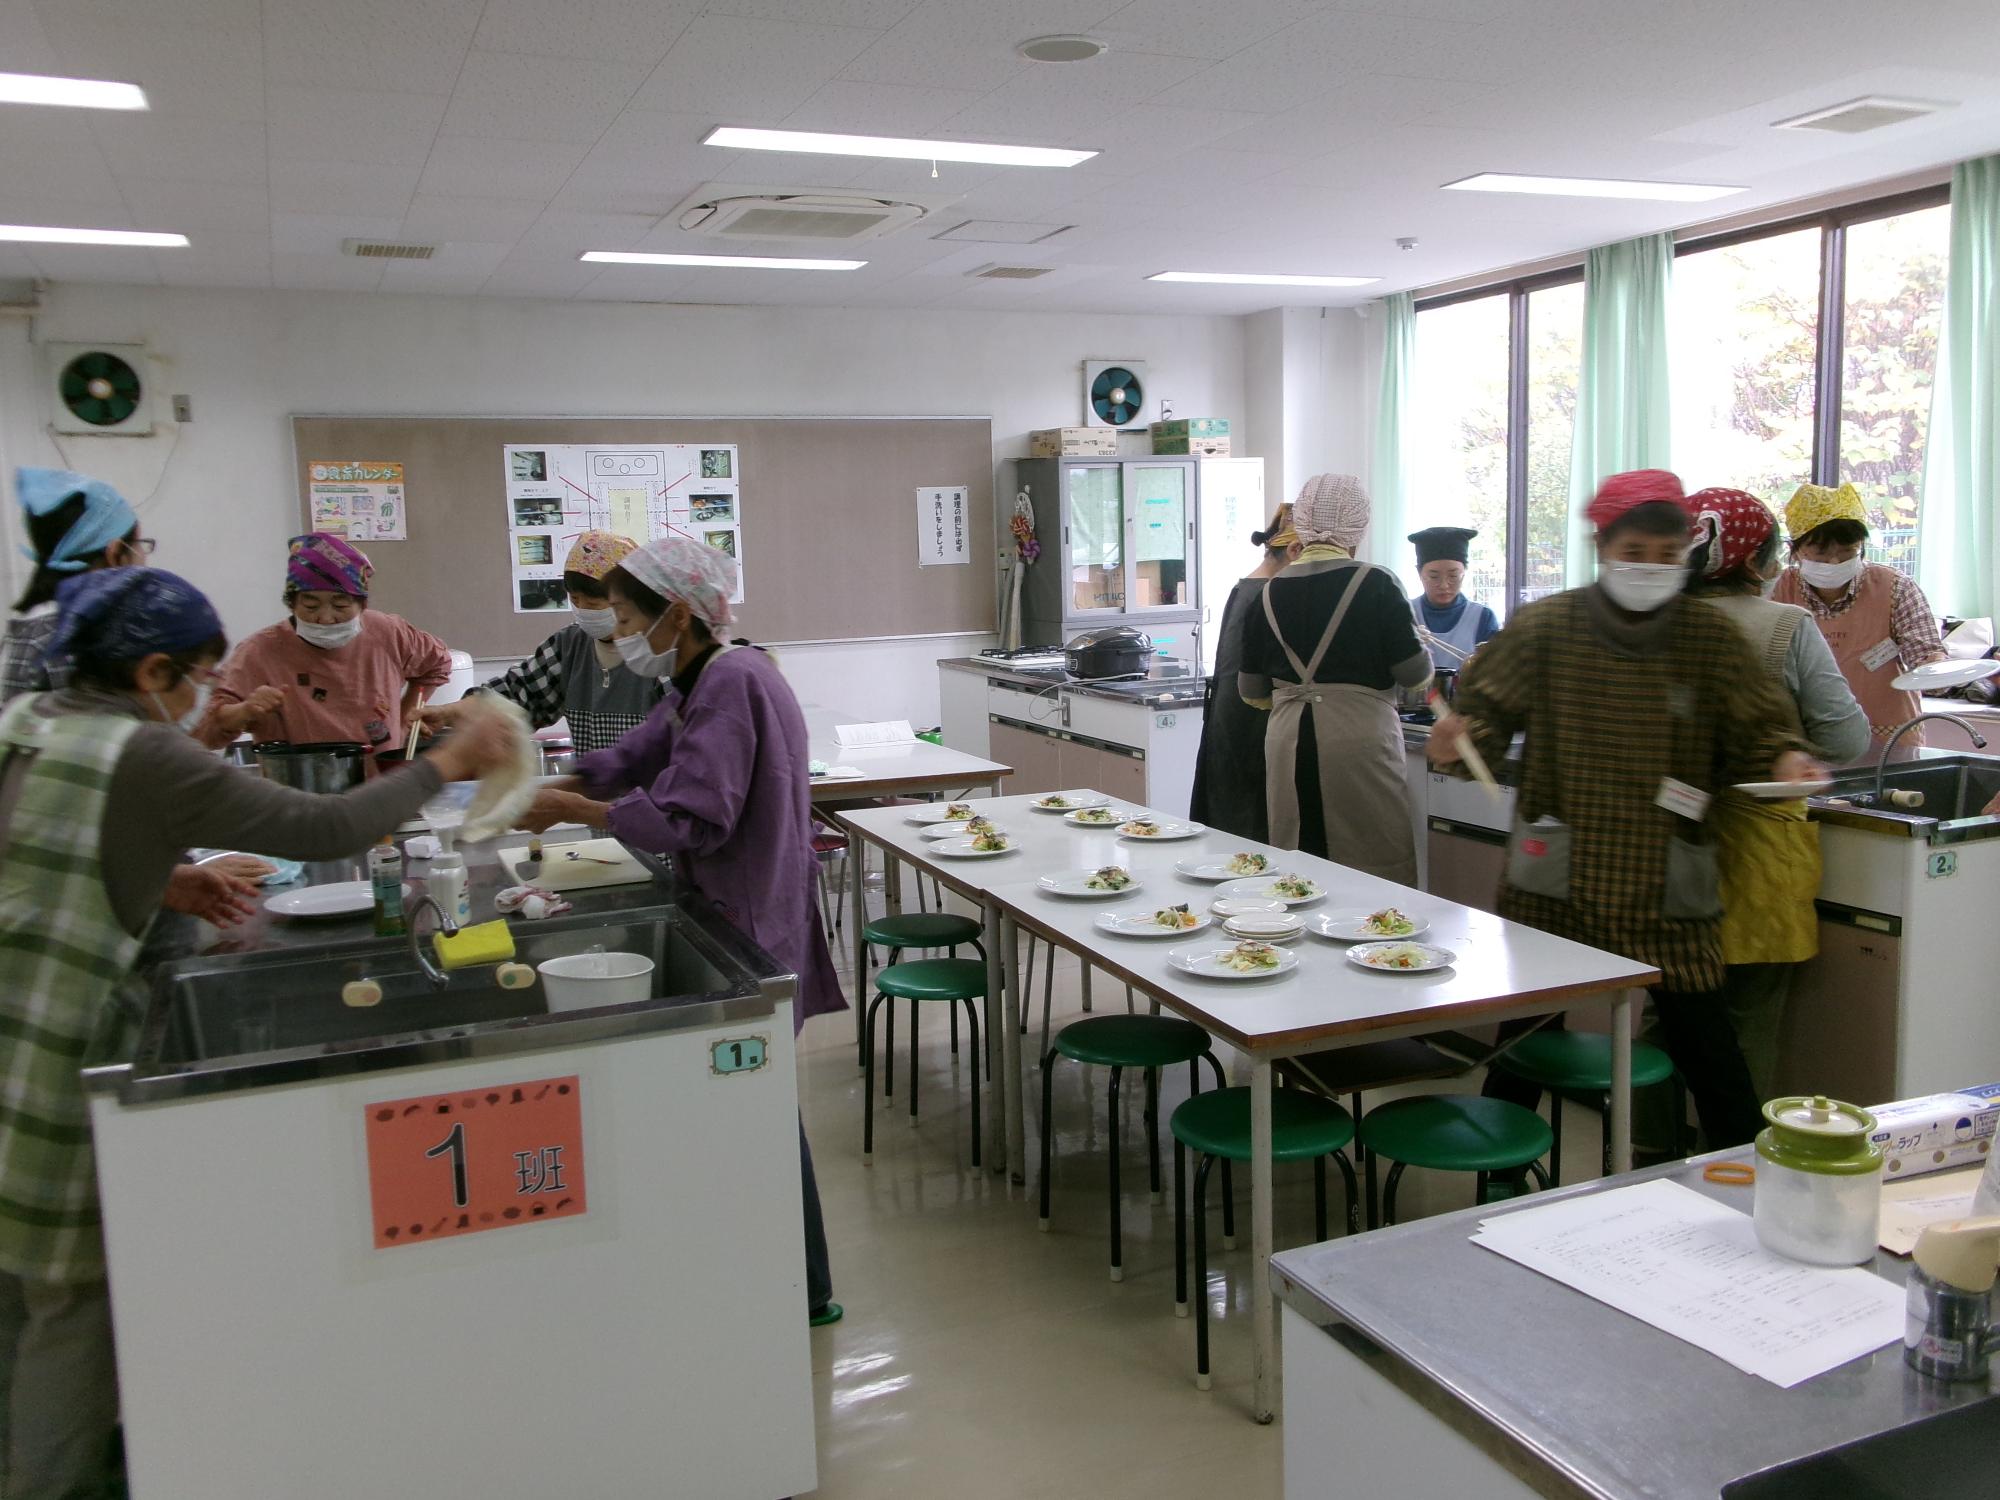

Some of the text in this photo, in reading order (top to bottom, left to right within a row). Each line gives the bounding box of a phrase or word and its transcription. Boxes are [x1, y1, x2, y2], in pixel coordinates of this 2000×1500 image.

[934, 492, 944, 557] 手洗いをしましょう
[953, 492, 963, 552] 調理の前には必ず
